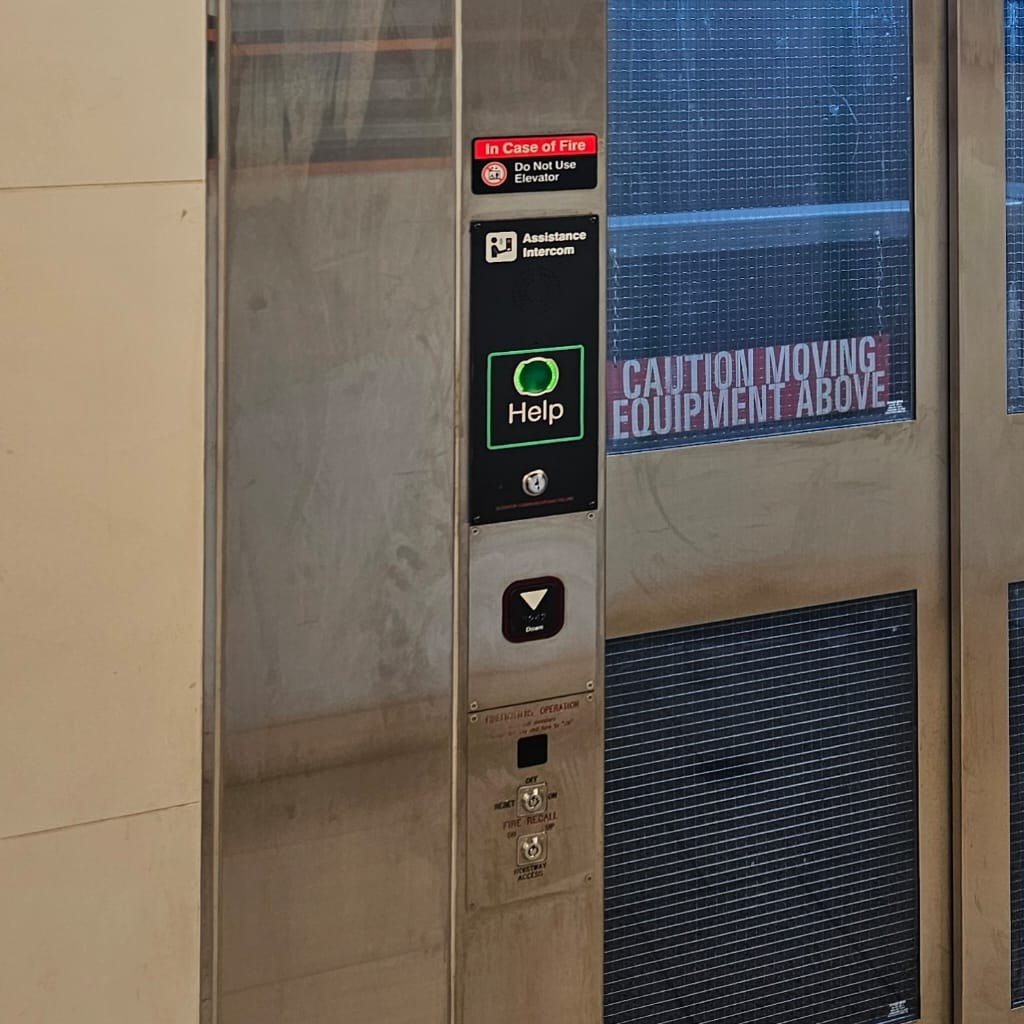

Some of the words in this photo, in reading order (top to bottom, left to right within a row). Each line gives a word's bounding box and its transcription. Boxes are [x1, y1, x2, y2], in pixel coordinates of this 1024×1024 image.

[485, 144, 499, 155] In
[502, 141, 539, 154] Case
[541, 140, 556, 151] of
[559, 139, 586, 151] Fire
[514, 162, 531, 172] Do
[533, 160, 553, 171] Not
[555, 159, 577, 170] Use
[514, 173, 560, 184] Elevator
[522, 231, 587, 243] Assistance
[523, 246, 575, 258] Intercom
[622, 348, 755, 400] CAUTION
[764, 336, 876, 382] MOVING
[612, 382, 786, 440] EQUIPMENT
[796, 370, 886, 418] ABOVE
[508, 400, 564, 425] Help
[526, 812, 558, 825] RECALL
